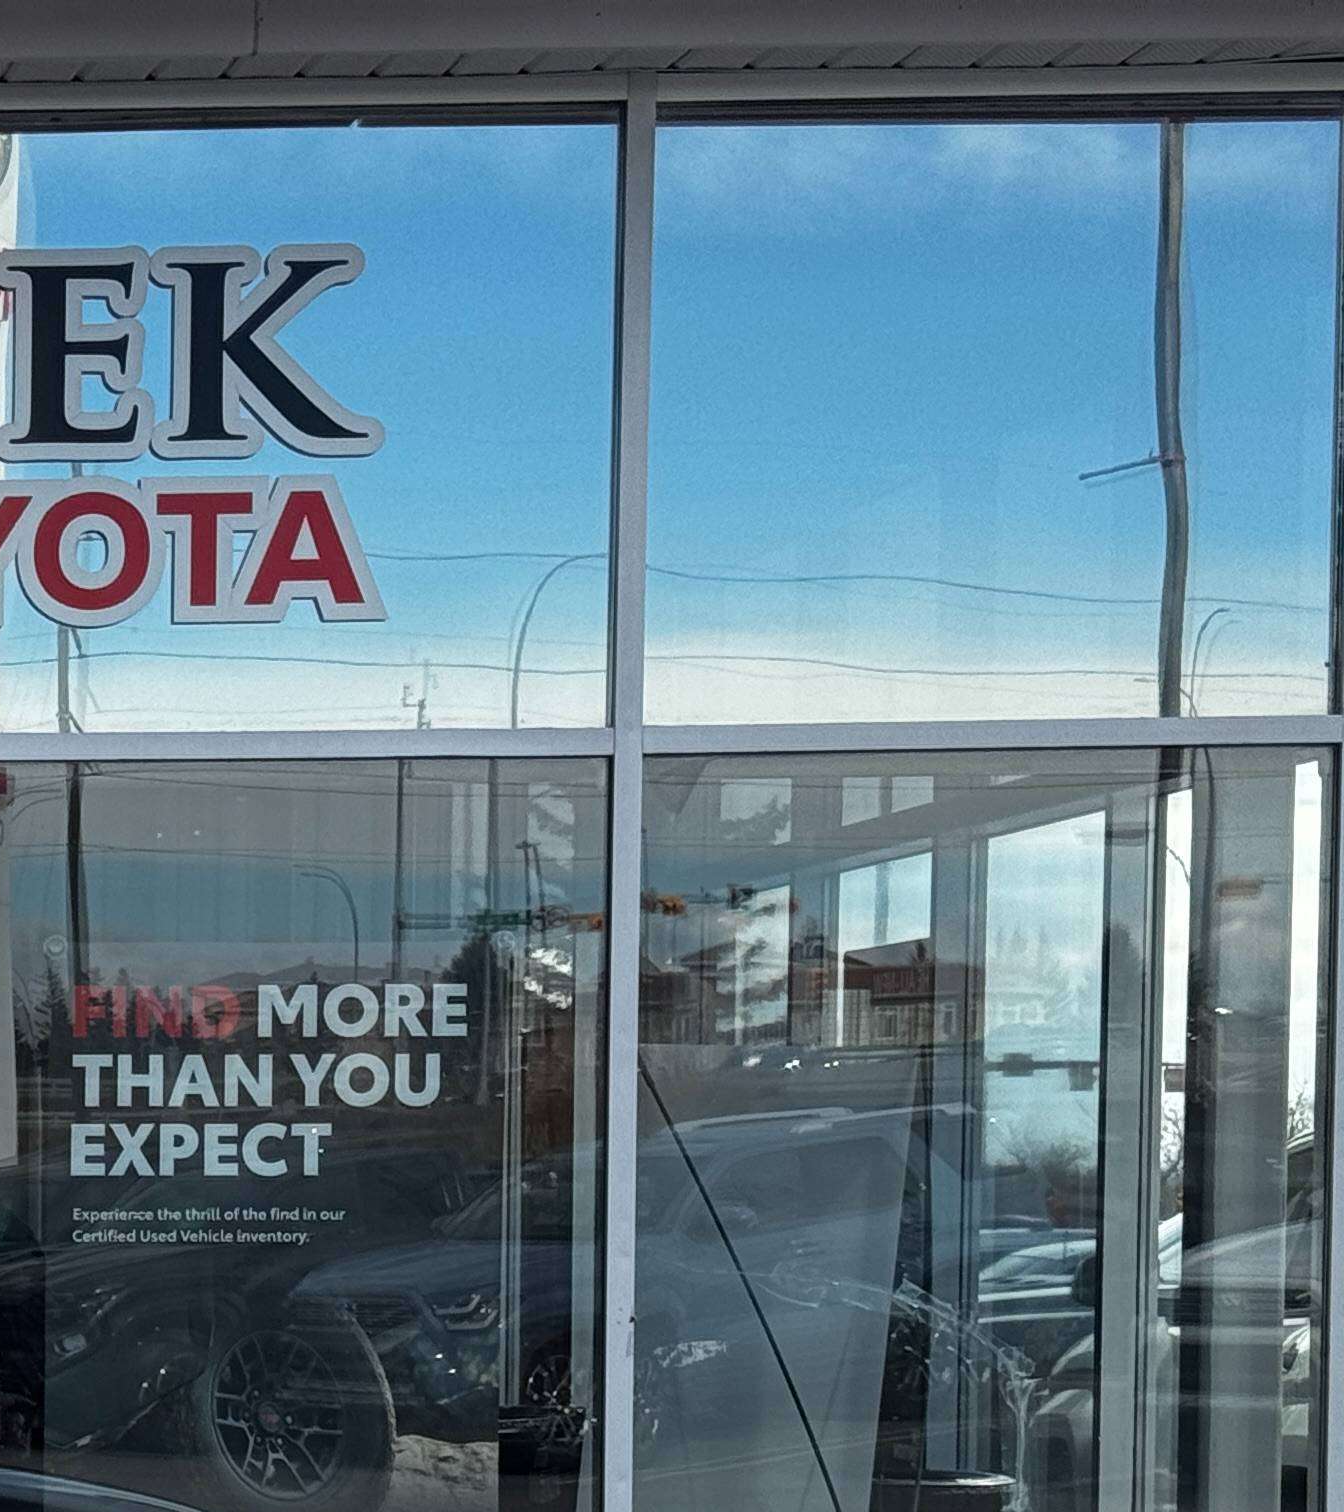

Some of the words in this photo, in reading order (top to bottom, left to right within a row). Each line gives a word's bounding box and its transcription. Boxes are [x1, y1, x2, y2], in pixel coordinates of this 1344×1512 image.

[71, 983, 242, 1039] FIND
[256, 982, 469, 1038] MORE
[71, 1053, 274, 1108] THAN
[289, 1051, 442, 1108] YOU
[69, 1122, 333, 1177] EXPECT
[72, 1207, 154, 1224] Experience
[157, 1207, 182, 1221] the
[185, 1206, 222, 1221] thrill
[223, 1206, 240, 1221] of
[242, 1206, 267, 1221] the
[269, 1206, 300, 1221] find
[302, 1206, 317, 1221] in
[319, 1209, 346, 1221] our
[72, 1228, 137, 1243] Certified
[140, 1229, 178, 1243] Used
[179, 1228, 234, 1243] Vehicle
